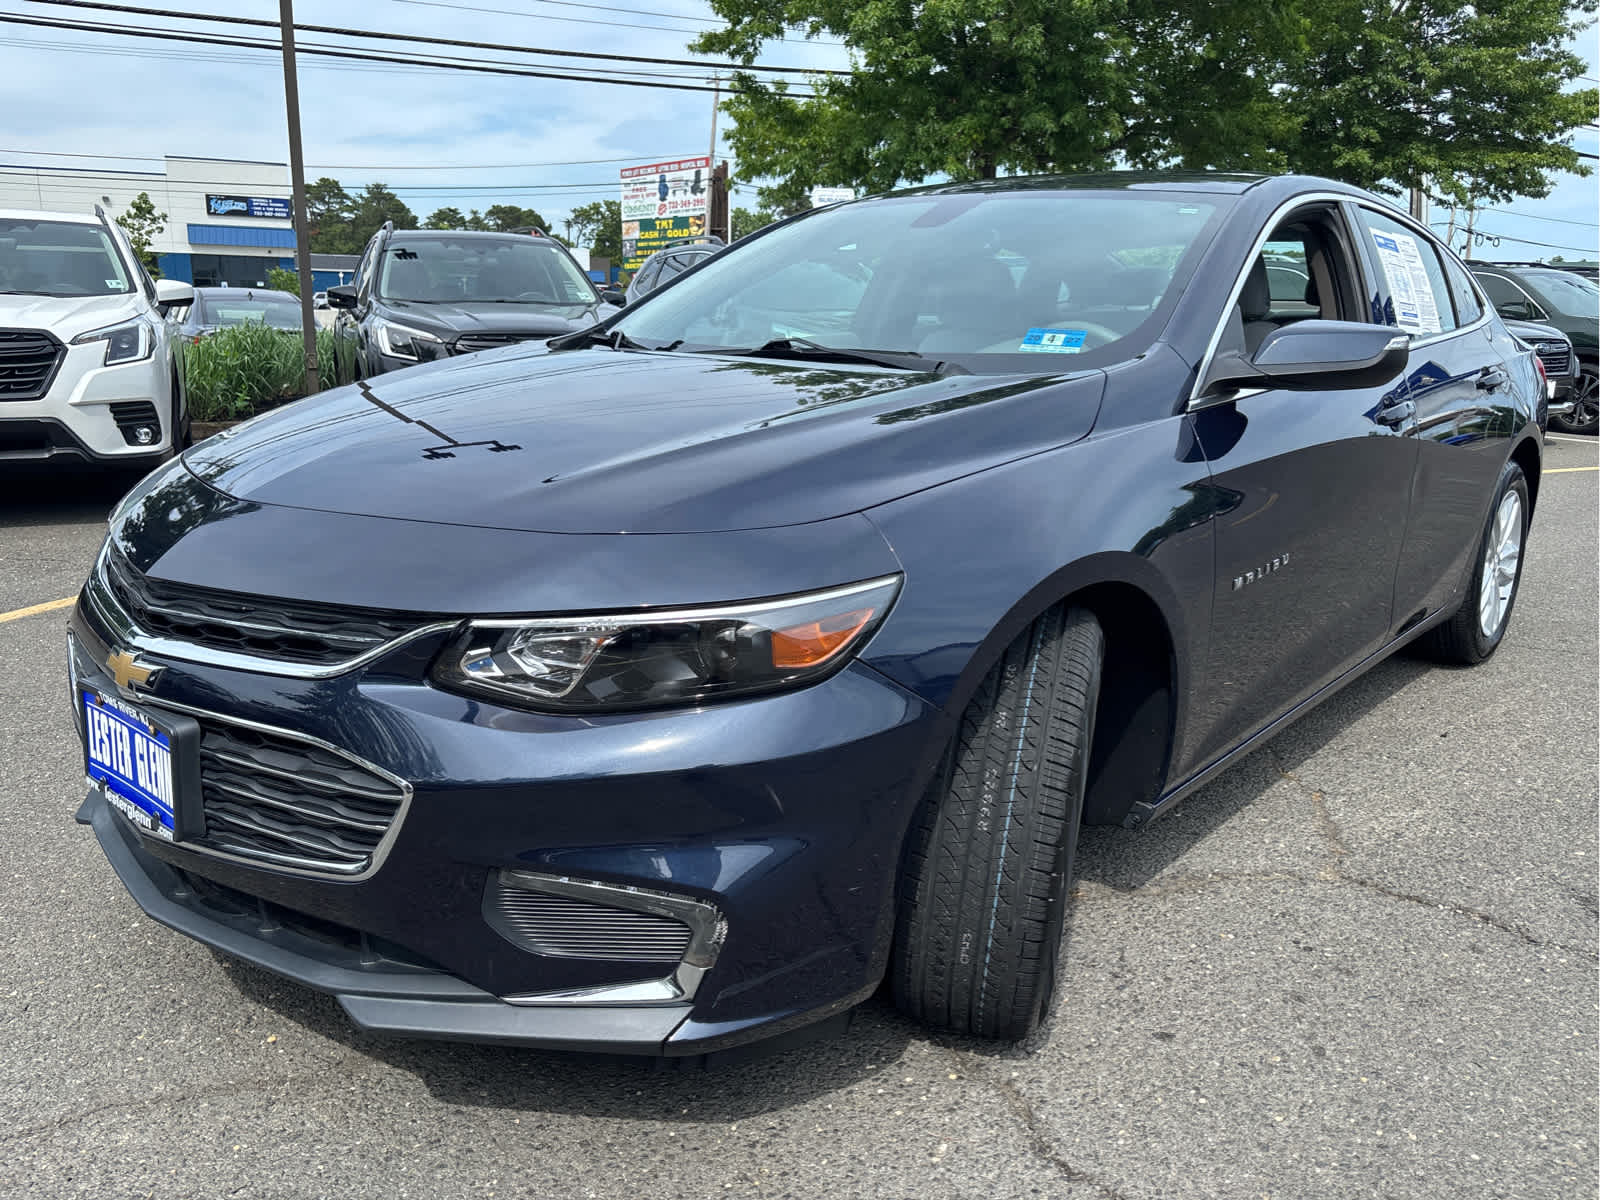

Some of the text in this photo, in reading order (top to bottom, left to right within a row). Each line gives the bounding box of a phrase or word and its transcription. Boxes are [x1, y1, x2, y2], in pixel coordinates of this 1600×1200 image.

[655, 219, 673, 229] TMT
[639, 231, 659, 239] CASH
[666, 228, 689, 237] GOLD
[1048, 334, 1056, 344] 4
[1234, 552, 1289, 591] MALIBU
[98, 691, 118, 709] TOMS
[87, 706, 174, 809] LESTER GLENN
